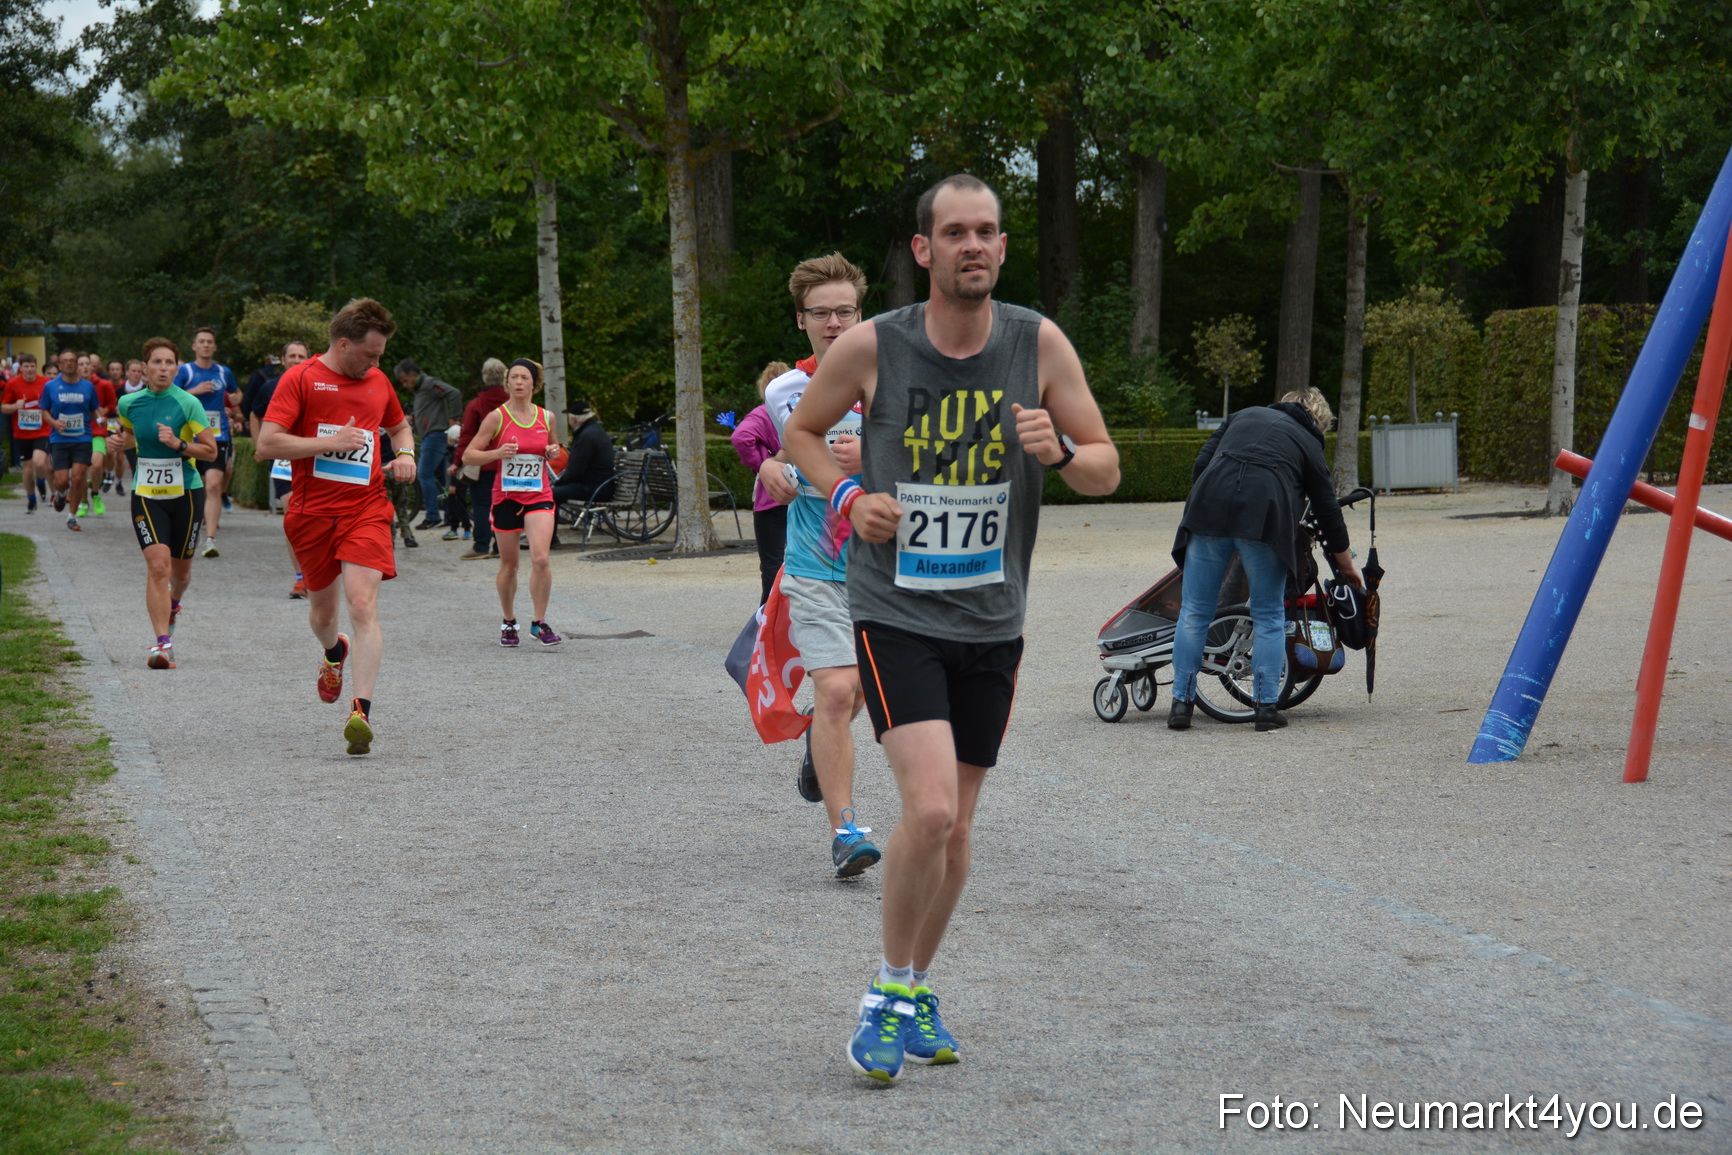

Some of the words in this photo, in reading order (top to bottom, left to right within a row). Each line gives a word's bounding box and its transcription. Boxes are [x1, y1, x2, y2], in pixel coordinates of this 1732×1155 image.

[904, 387, 1004, 441] RUN
[62, 419, 82, 428] 672
[506, 462, 541, 477] 2723
[904, 438, 1005, 486] THIS
[146, 468, 174, 485] 275
[900, 493, 936, 506] PARTL
[939, 495, 993, 507] Neumarkt
[908, 509, 1000, 549] 2176
[915, 558, 988, 576] Alexander
